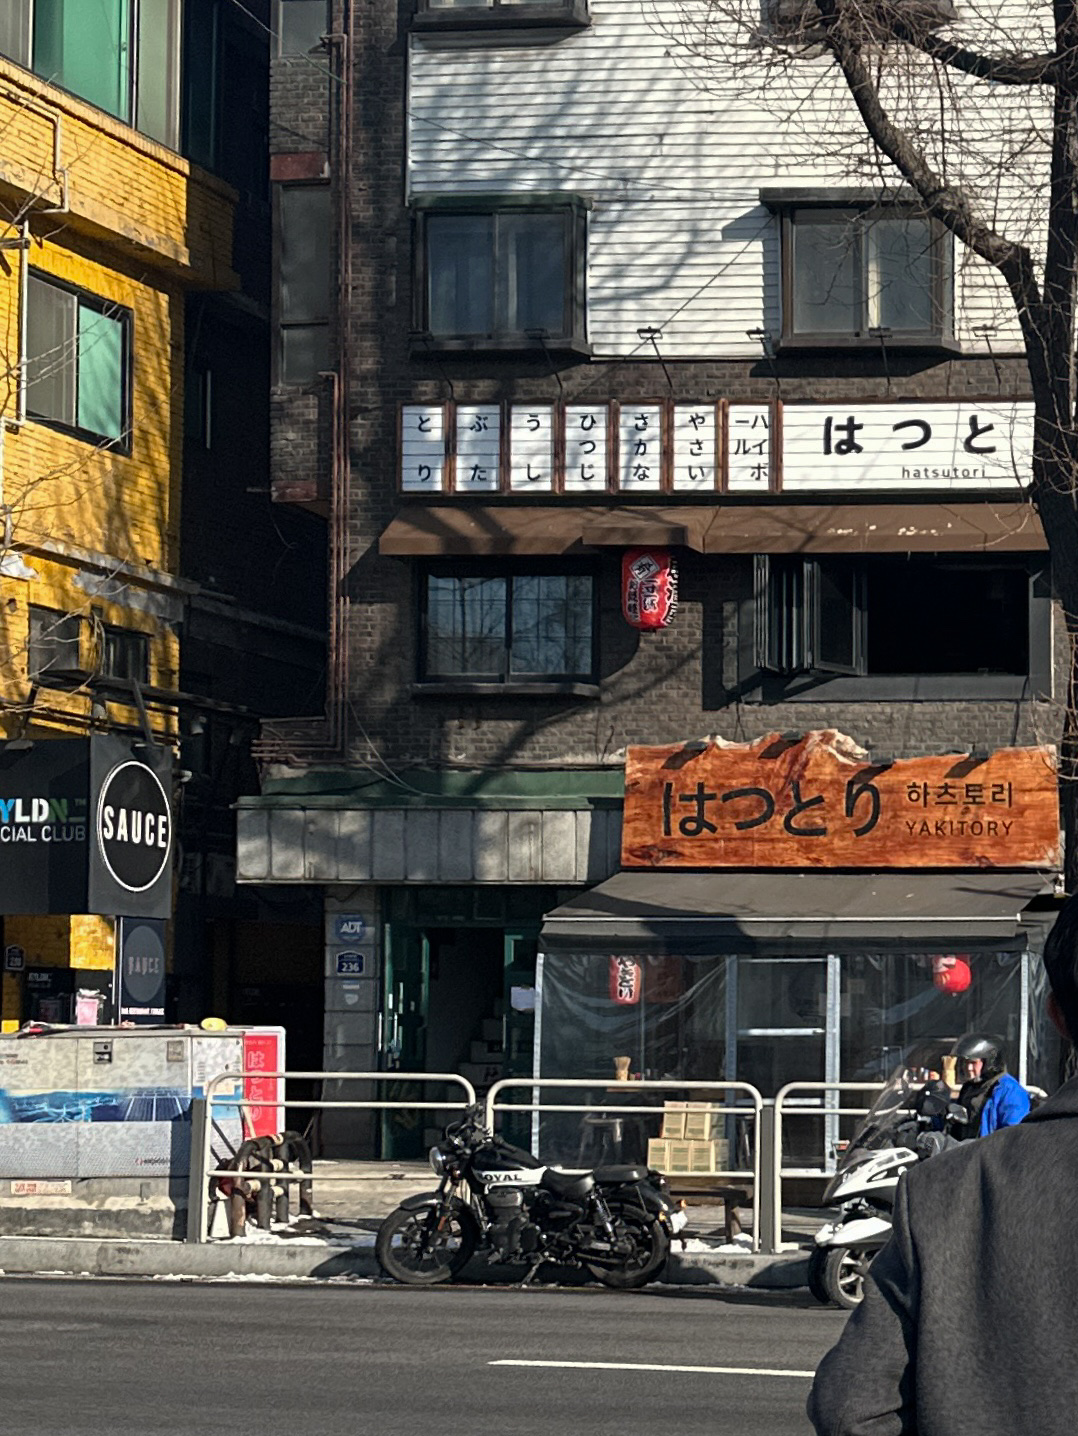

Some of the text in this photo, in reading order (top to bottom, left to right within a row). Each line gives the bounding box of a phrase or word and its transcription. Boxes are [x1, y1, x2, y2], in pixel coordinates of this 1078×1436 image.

[417, 415, 432, 482] とり
[470, 415, 489, 482] ぶた
[526, 414, 541, 481] うし
[579, 414, 597, 481] ひつじ
[633, 413, 650, 481] さかな
[688, 412, 706, 481] やさい
[902, 466, 986, 479] hatsutori
[663, 780, 882, 837] はつとり
[906, 781, 1013, 808] 하츠토리
[41, 825, 86, 841] CLUB
[103, 805, 168, 848] SAUCE
[905, 820, 1014, 837] YAKITORY
[341, 921, 363, 934] ADT
